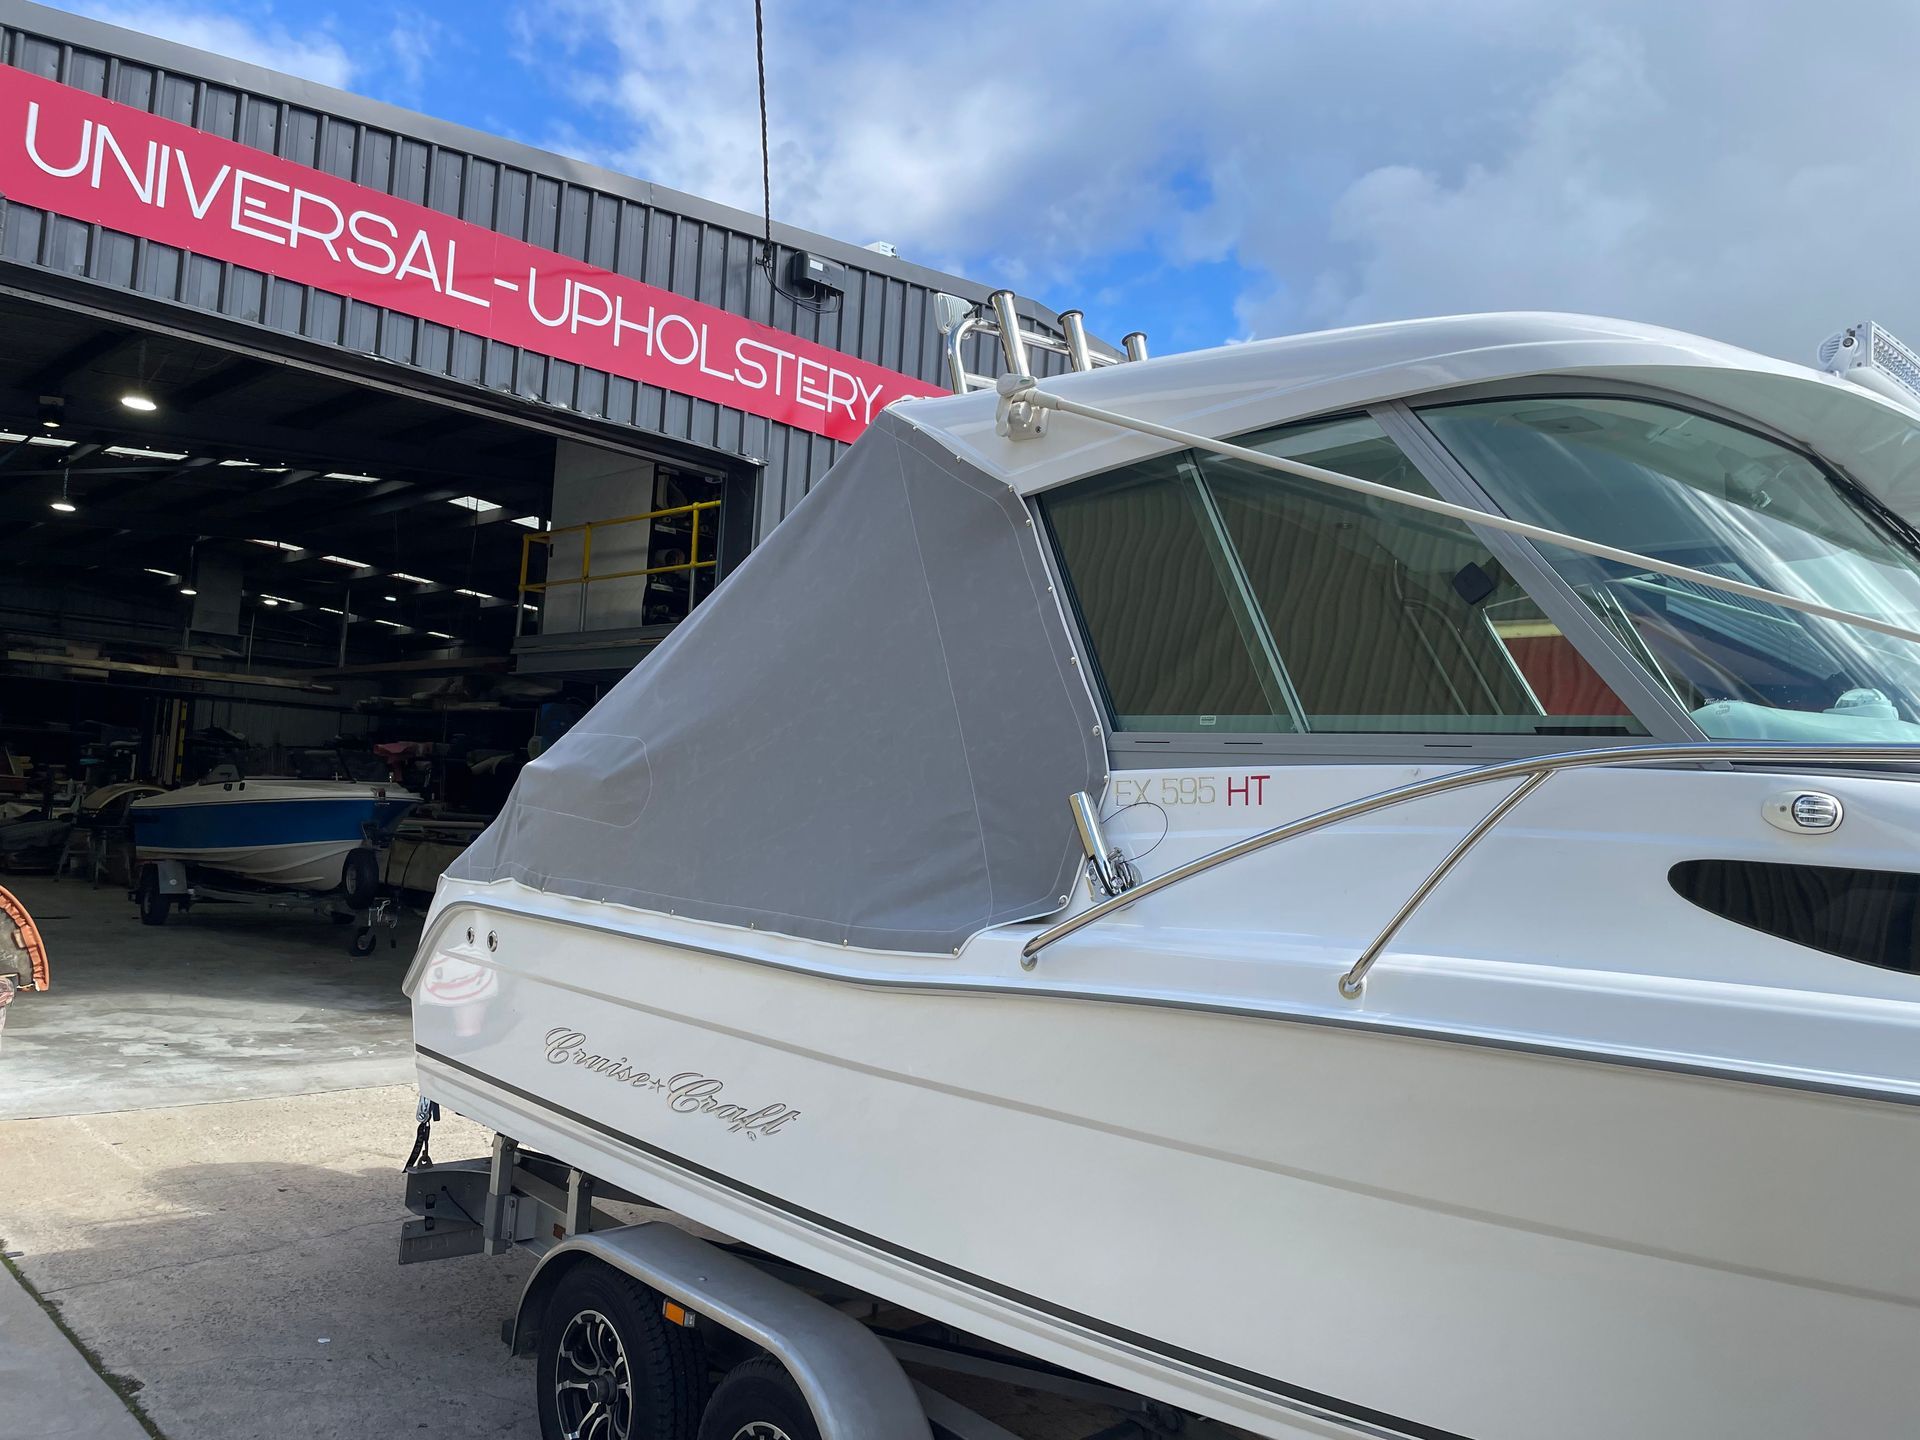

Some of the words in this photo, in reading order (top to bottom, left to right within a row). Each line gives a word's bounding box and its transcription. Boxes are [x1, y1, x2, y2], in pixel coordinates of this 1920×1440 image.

[1115, 779, 1151, 807] EX
[1162, 776, 1216, 805] 595
[1227, 775, 1270, 806] HT
